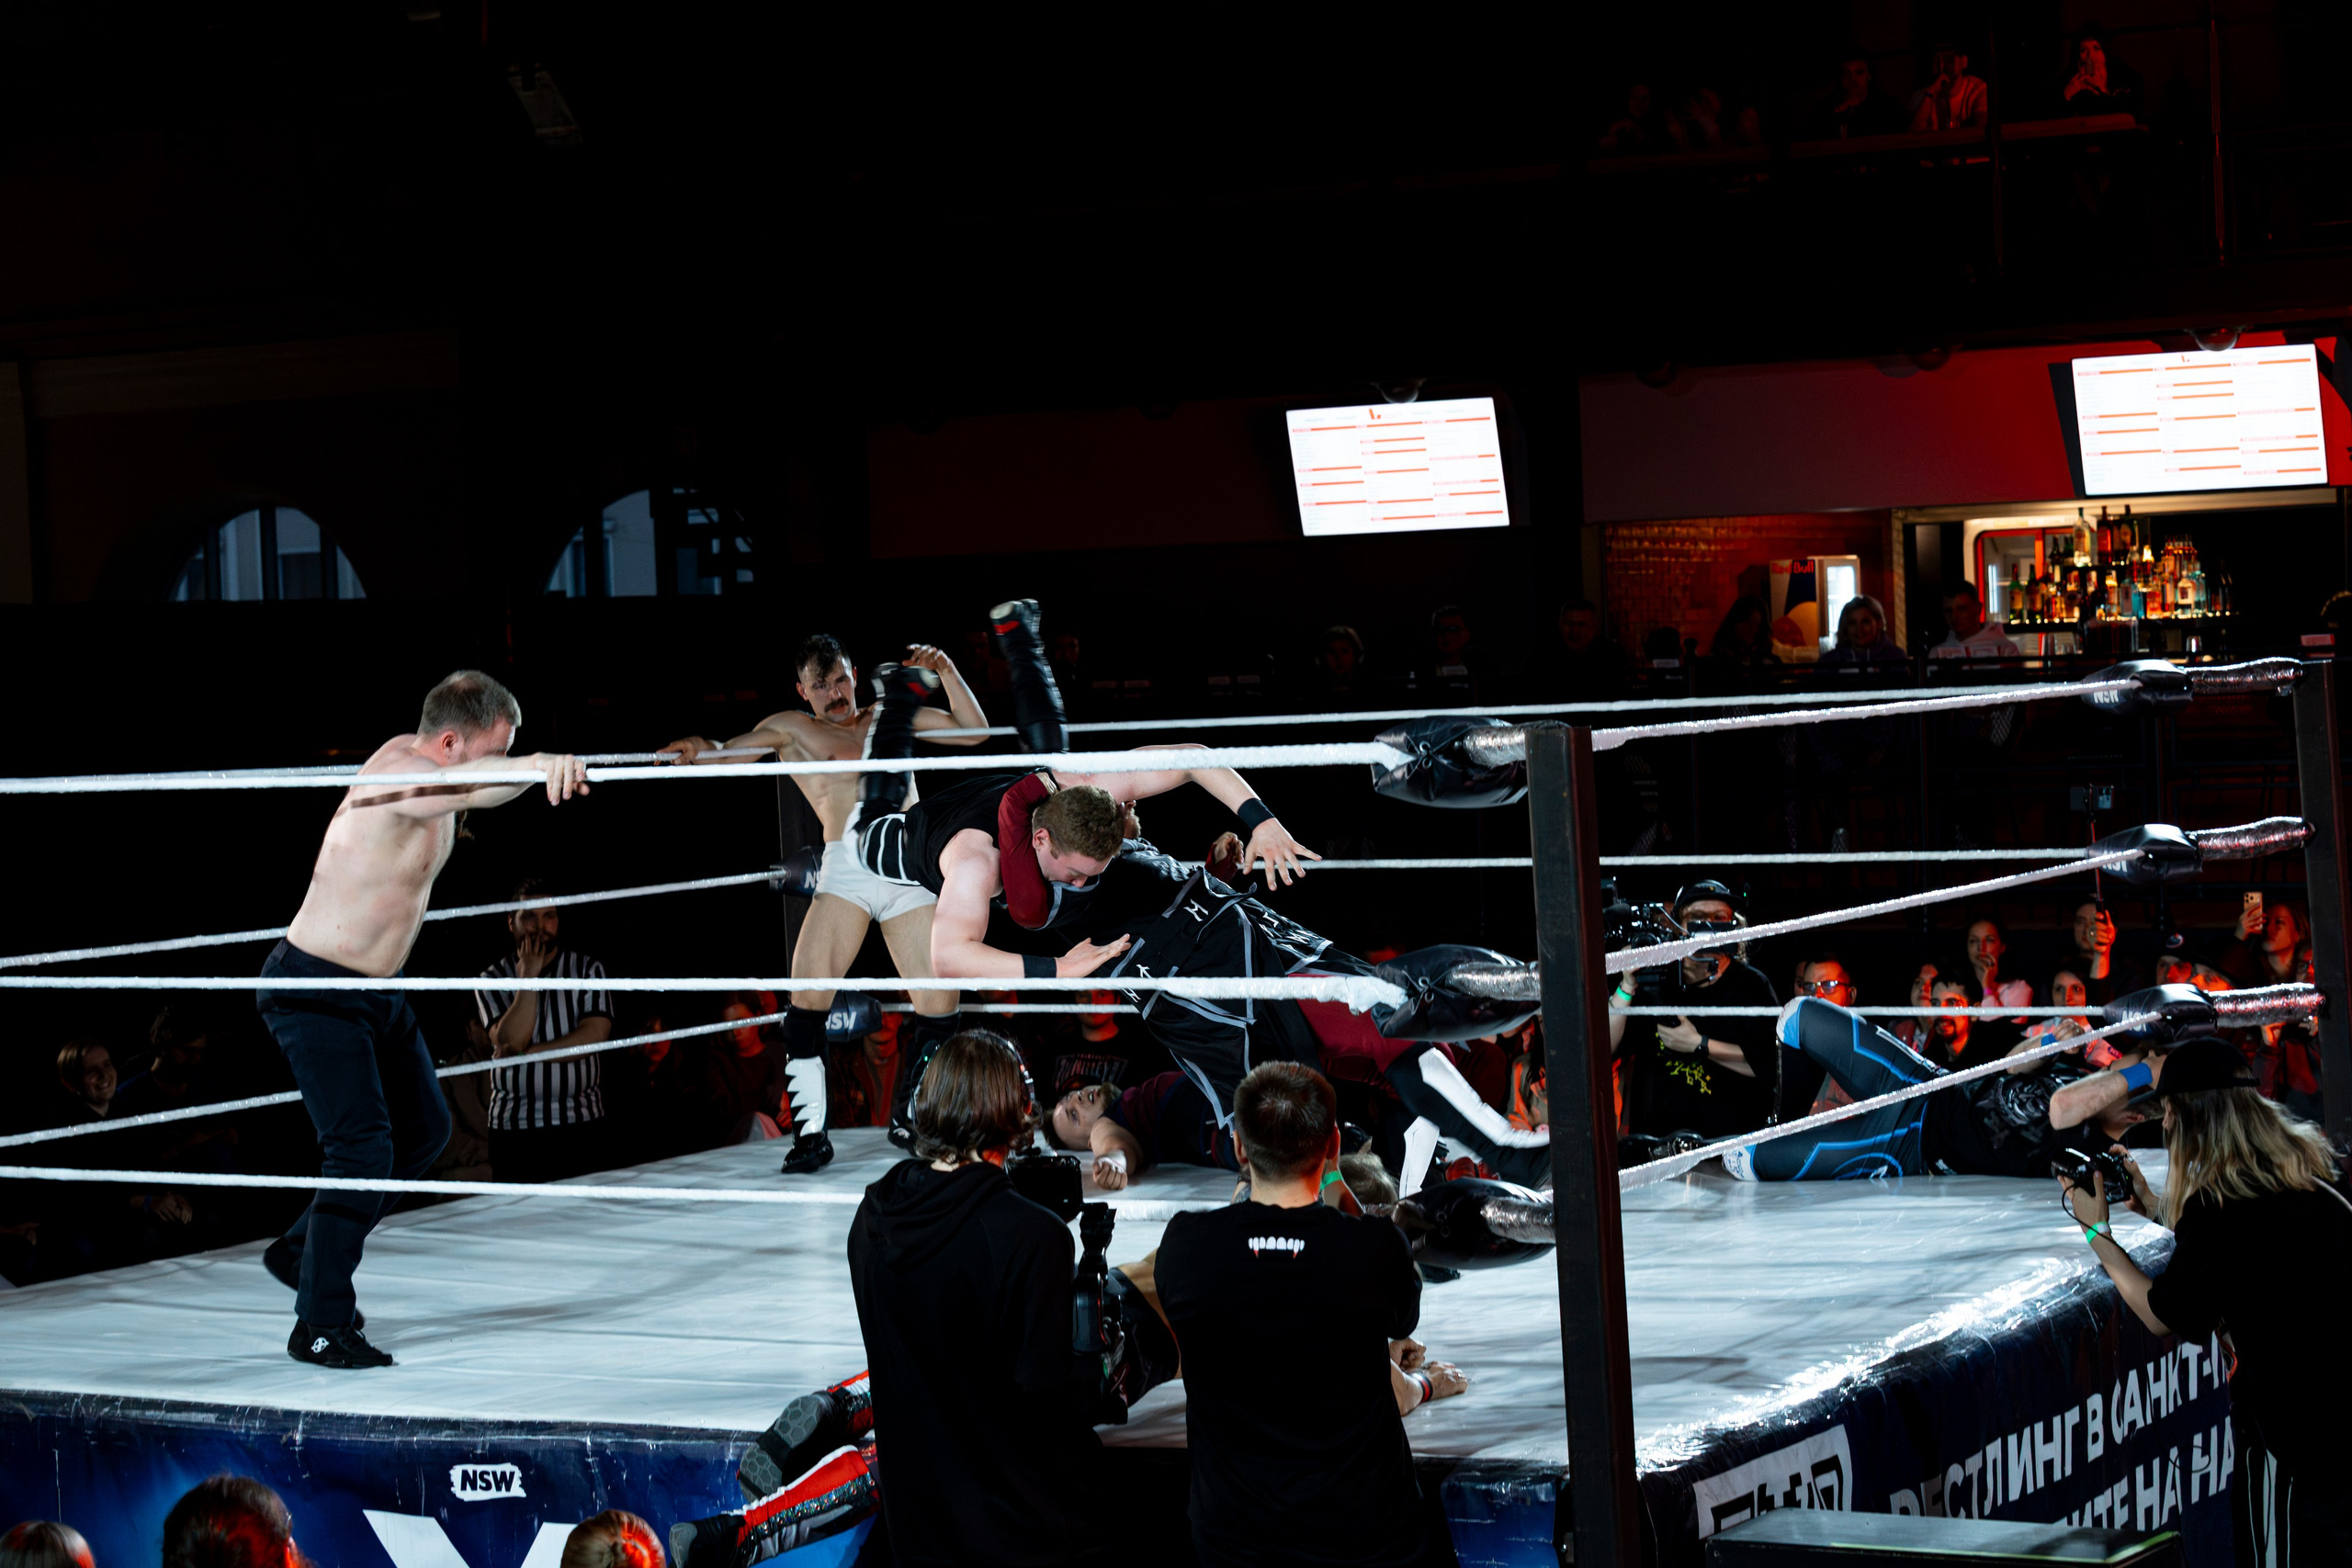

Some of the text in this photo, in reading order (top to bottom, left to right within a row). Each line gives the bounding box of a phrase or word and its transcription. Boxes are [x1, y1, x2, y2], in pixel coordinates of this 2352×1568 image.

[1792, 560, 1815, 574] Bull
[2086, 1393, 2104, 1463] В
[459, 1470, 516, 1493] NSW
[2135, 1445, 2183, 1531] НА
